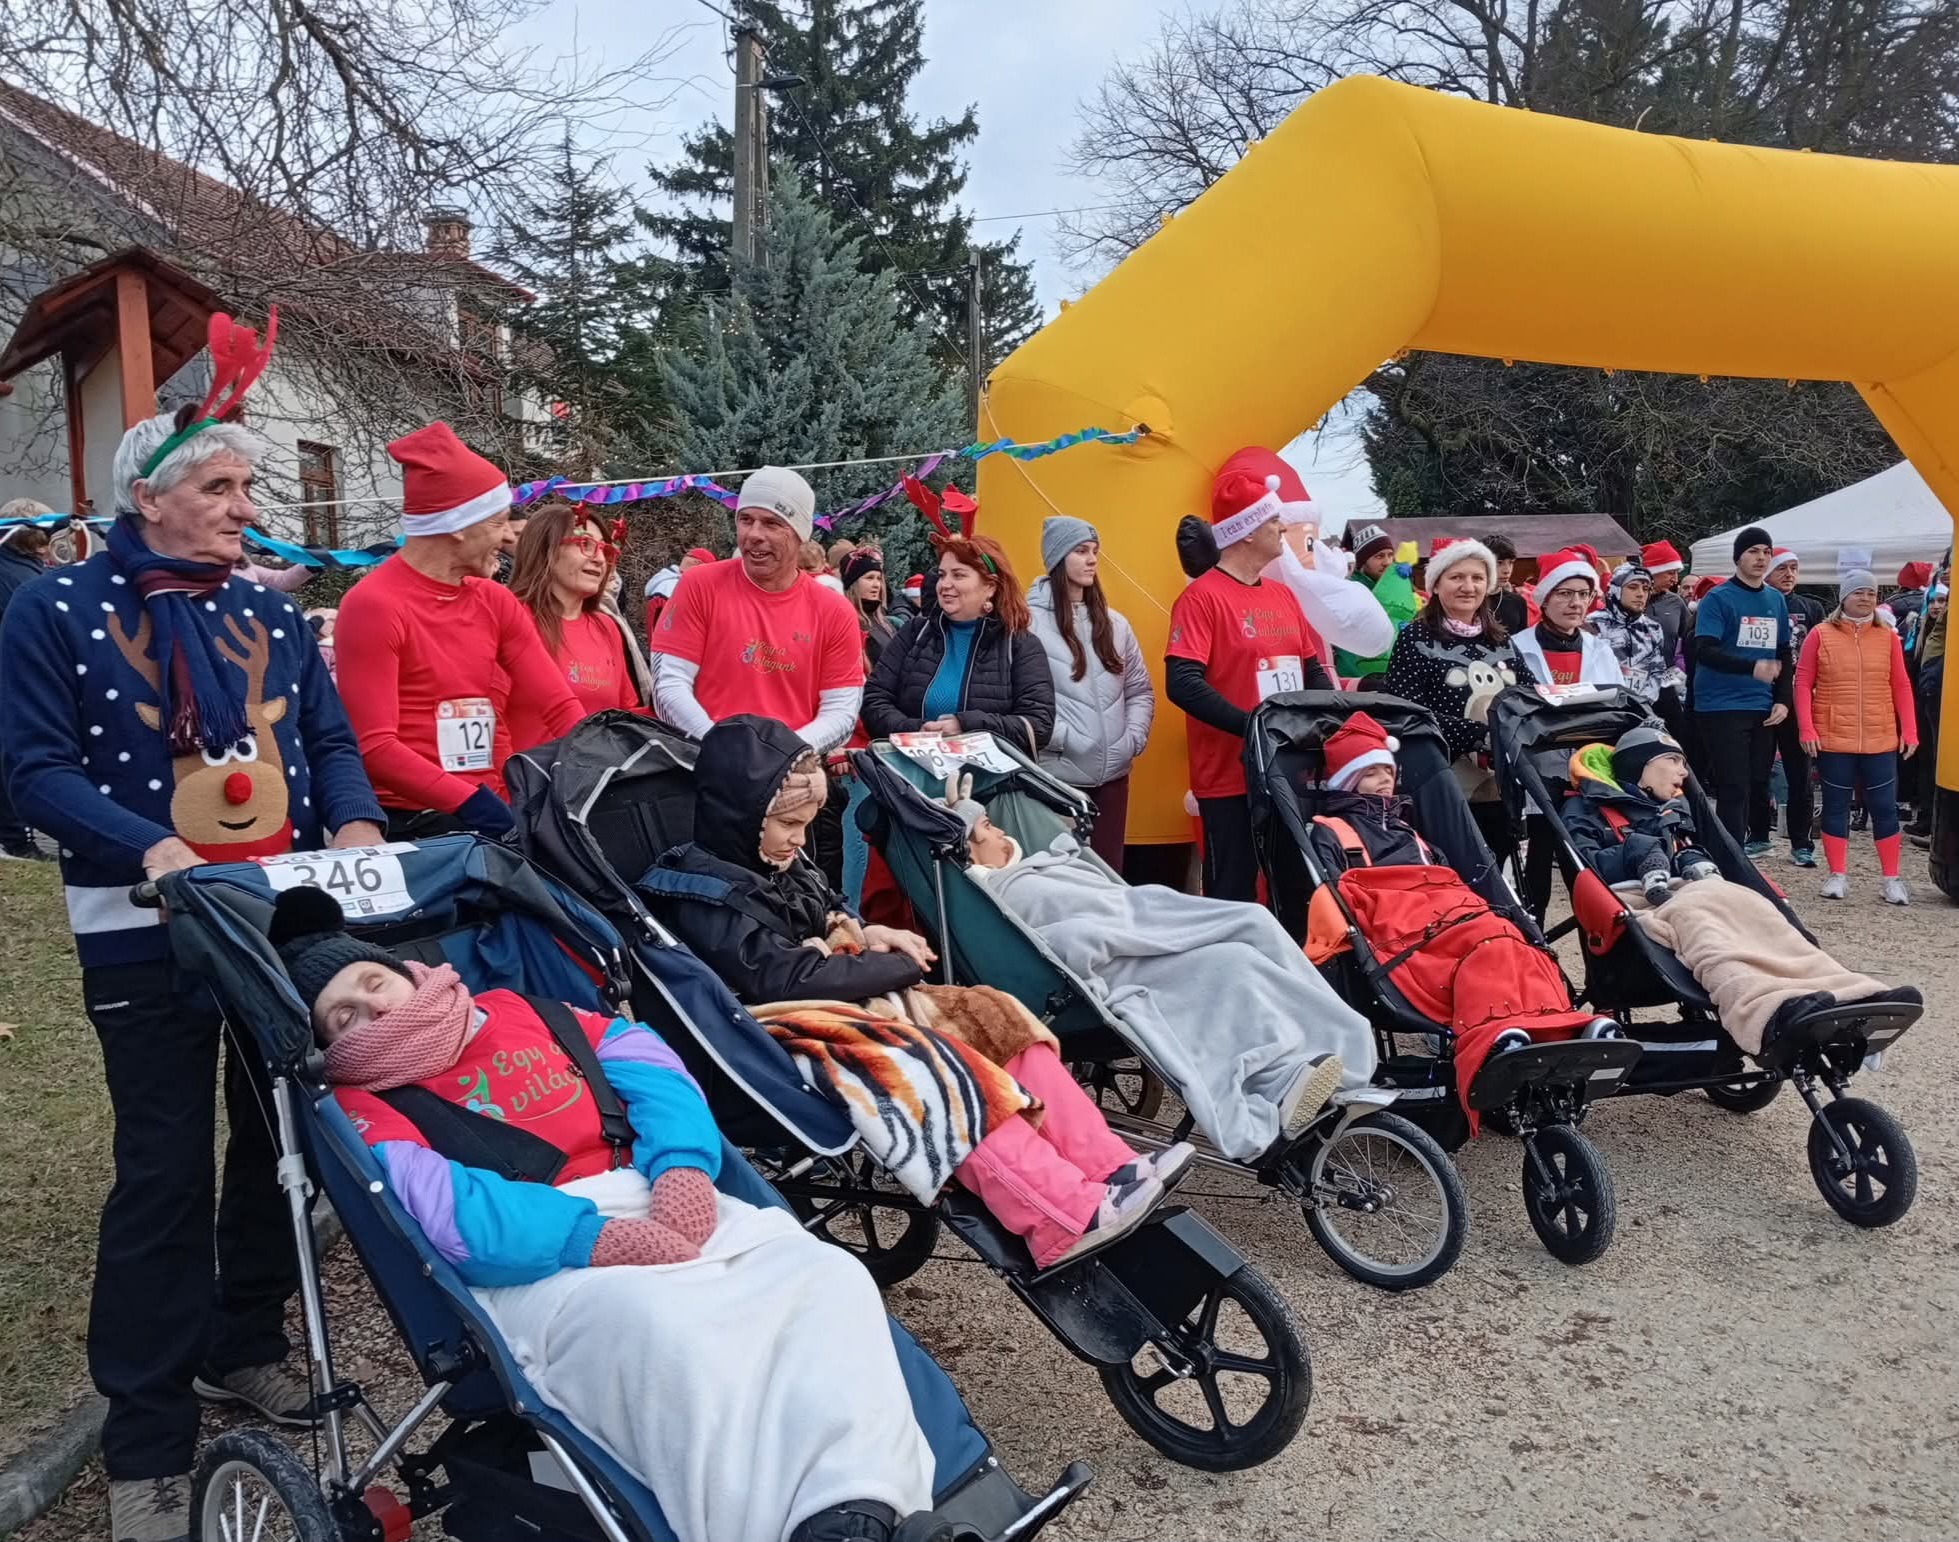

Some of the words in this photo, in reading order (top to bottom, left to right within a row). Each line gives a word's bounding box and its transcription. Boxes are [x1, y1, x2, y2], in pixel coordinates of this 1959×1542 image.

[1227, 522, 1245, 536] can
[1748, 626, 1770, 640] 103
[1271, 671, 1298, 691] 131
[1551, 669, 1575, 684] Egy
[458, 721, 492, 750] 121
[293, 857, 382, 895] 346
[492, 1046, 547, 1076] Egy
[551, 1043, 565, 1056] a
